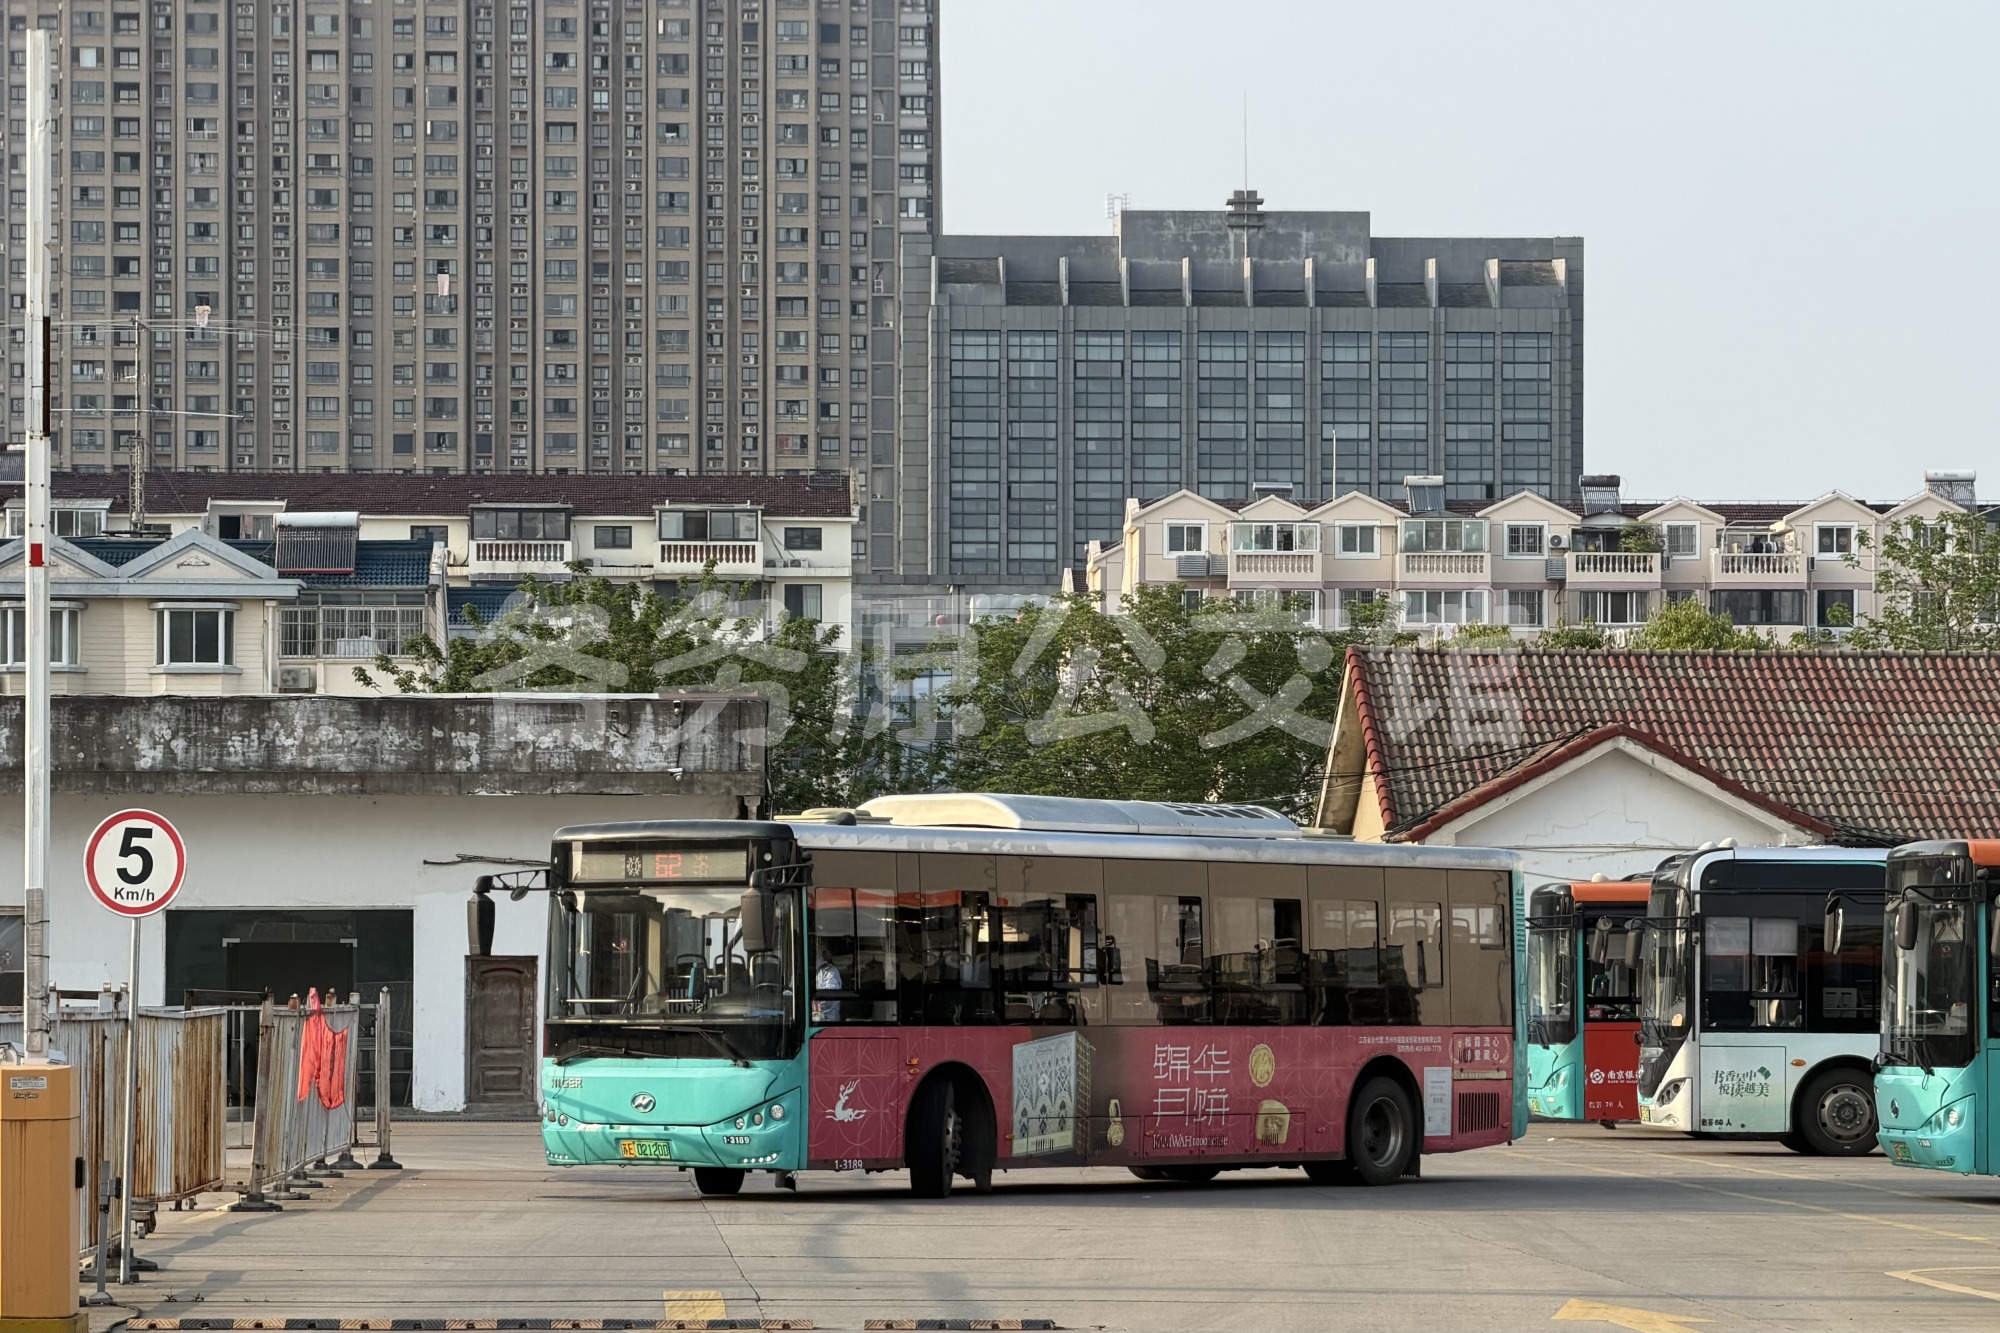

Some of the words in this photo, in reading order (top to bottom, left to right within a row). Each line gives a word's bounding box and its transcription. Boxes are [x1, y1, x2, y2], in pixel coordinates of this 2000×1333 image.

[116, 827, 153, 885] 5
[655, 853, 682, 877] 62
[114, 887, 155, 901] Km/h
[1153, 1044, 1230, 1083] 锦华
[1711, 1070, 1757, 1084] 书香吴中
[1719, 1082, 1770, 1097] 悦读越美
[1152, 1087, 1230, 1127] 月饼
[723, 1136, 750, 1145] 1-3189
[834, 1159, 863, 1170] 1-3189
